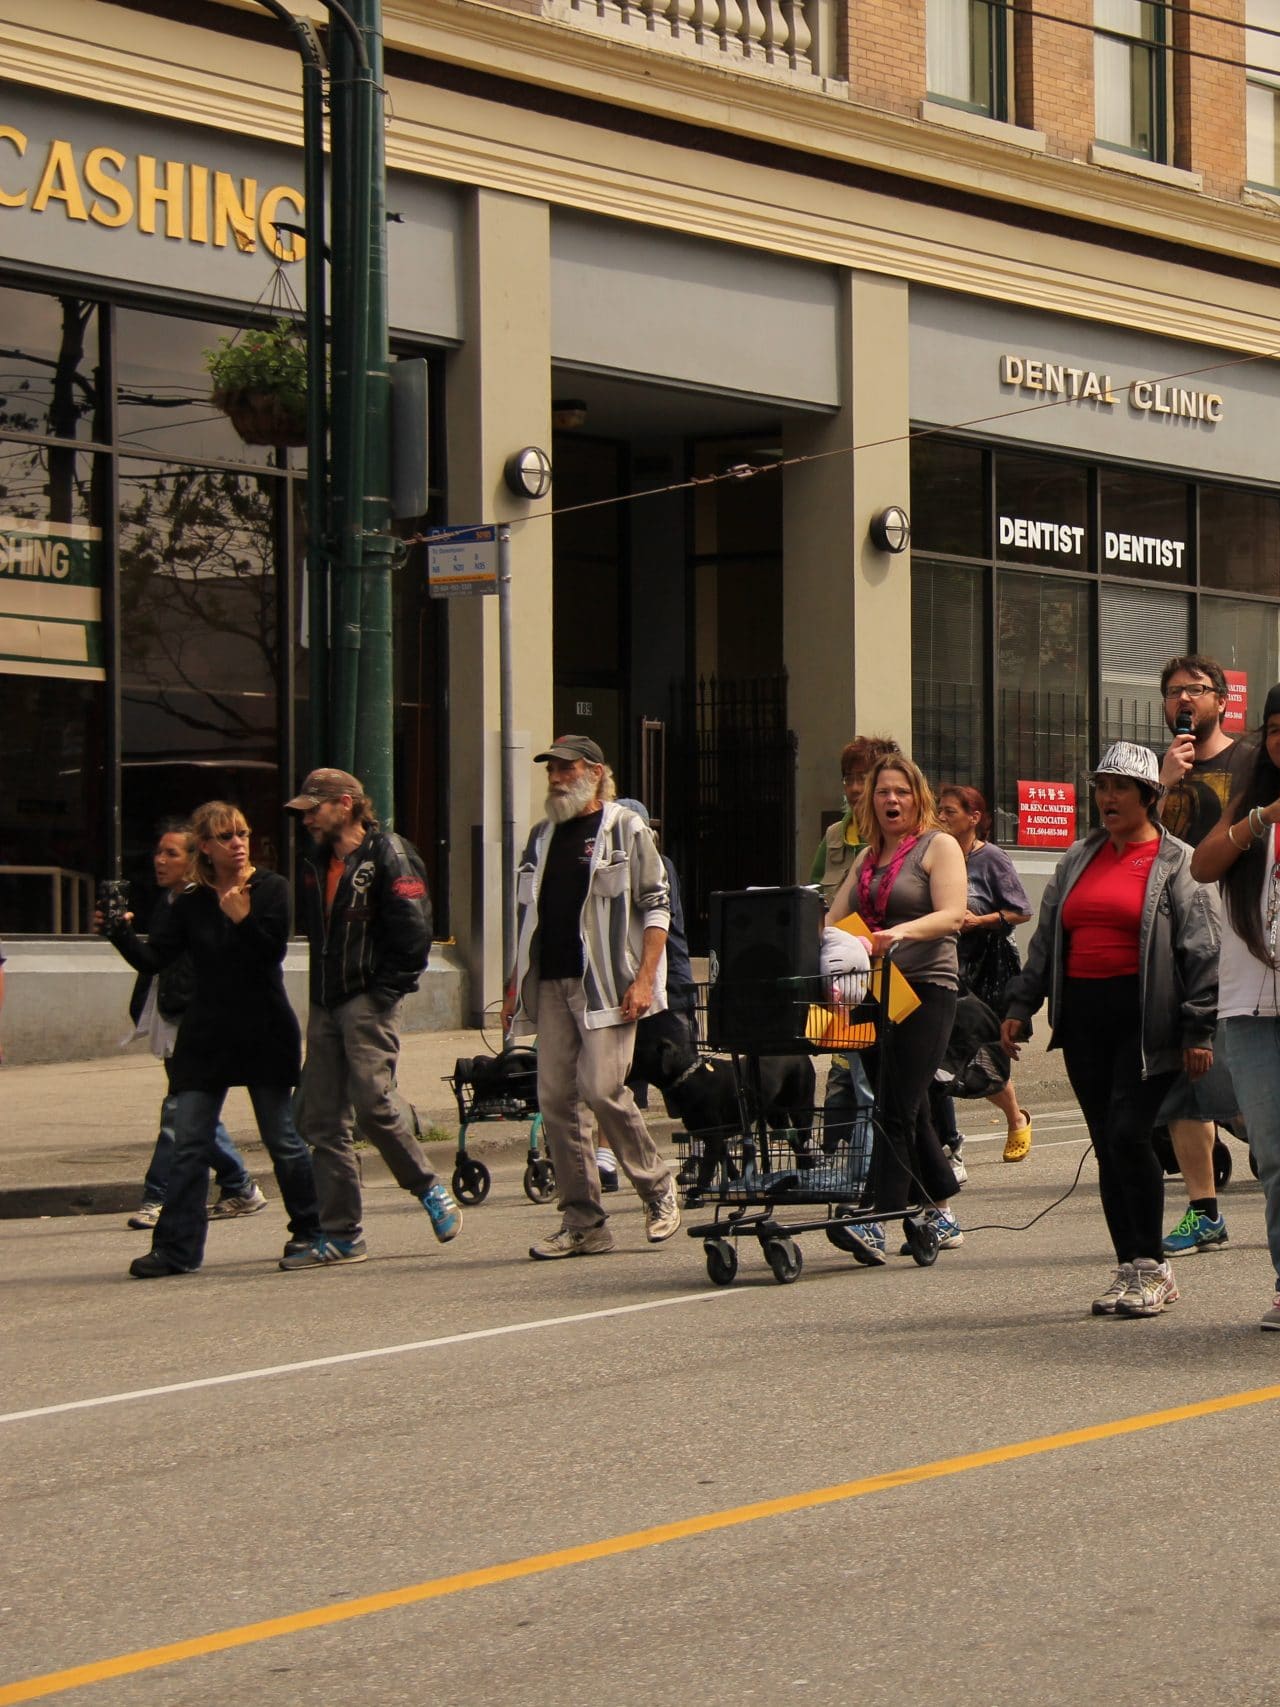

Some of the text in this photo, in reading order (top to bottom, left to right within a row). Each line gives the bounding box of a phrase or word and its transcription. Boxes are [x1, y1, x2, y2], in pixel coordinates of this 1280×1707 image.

[1001, 354, 1224, 423] DENTAL CLINIC
[1000, 516, 1185, 568] DENTIST DENTIST
[1033, 816, 1068, 825] ASSOCIATES
